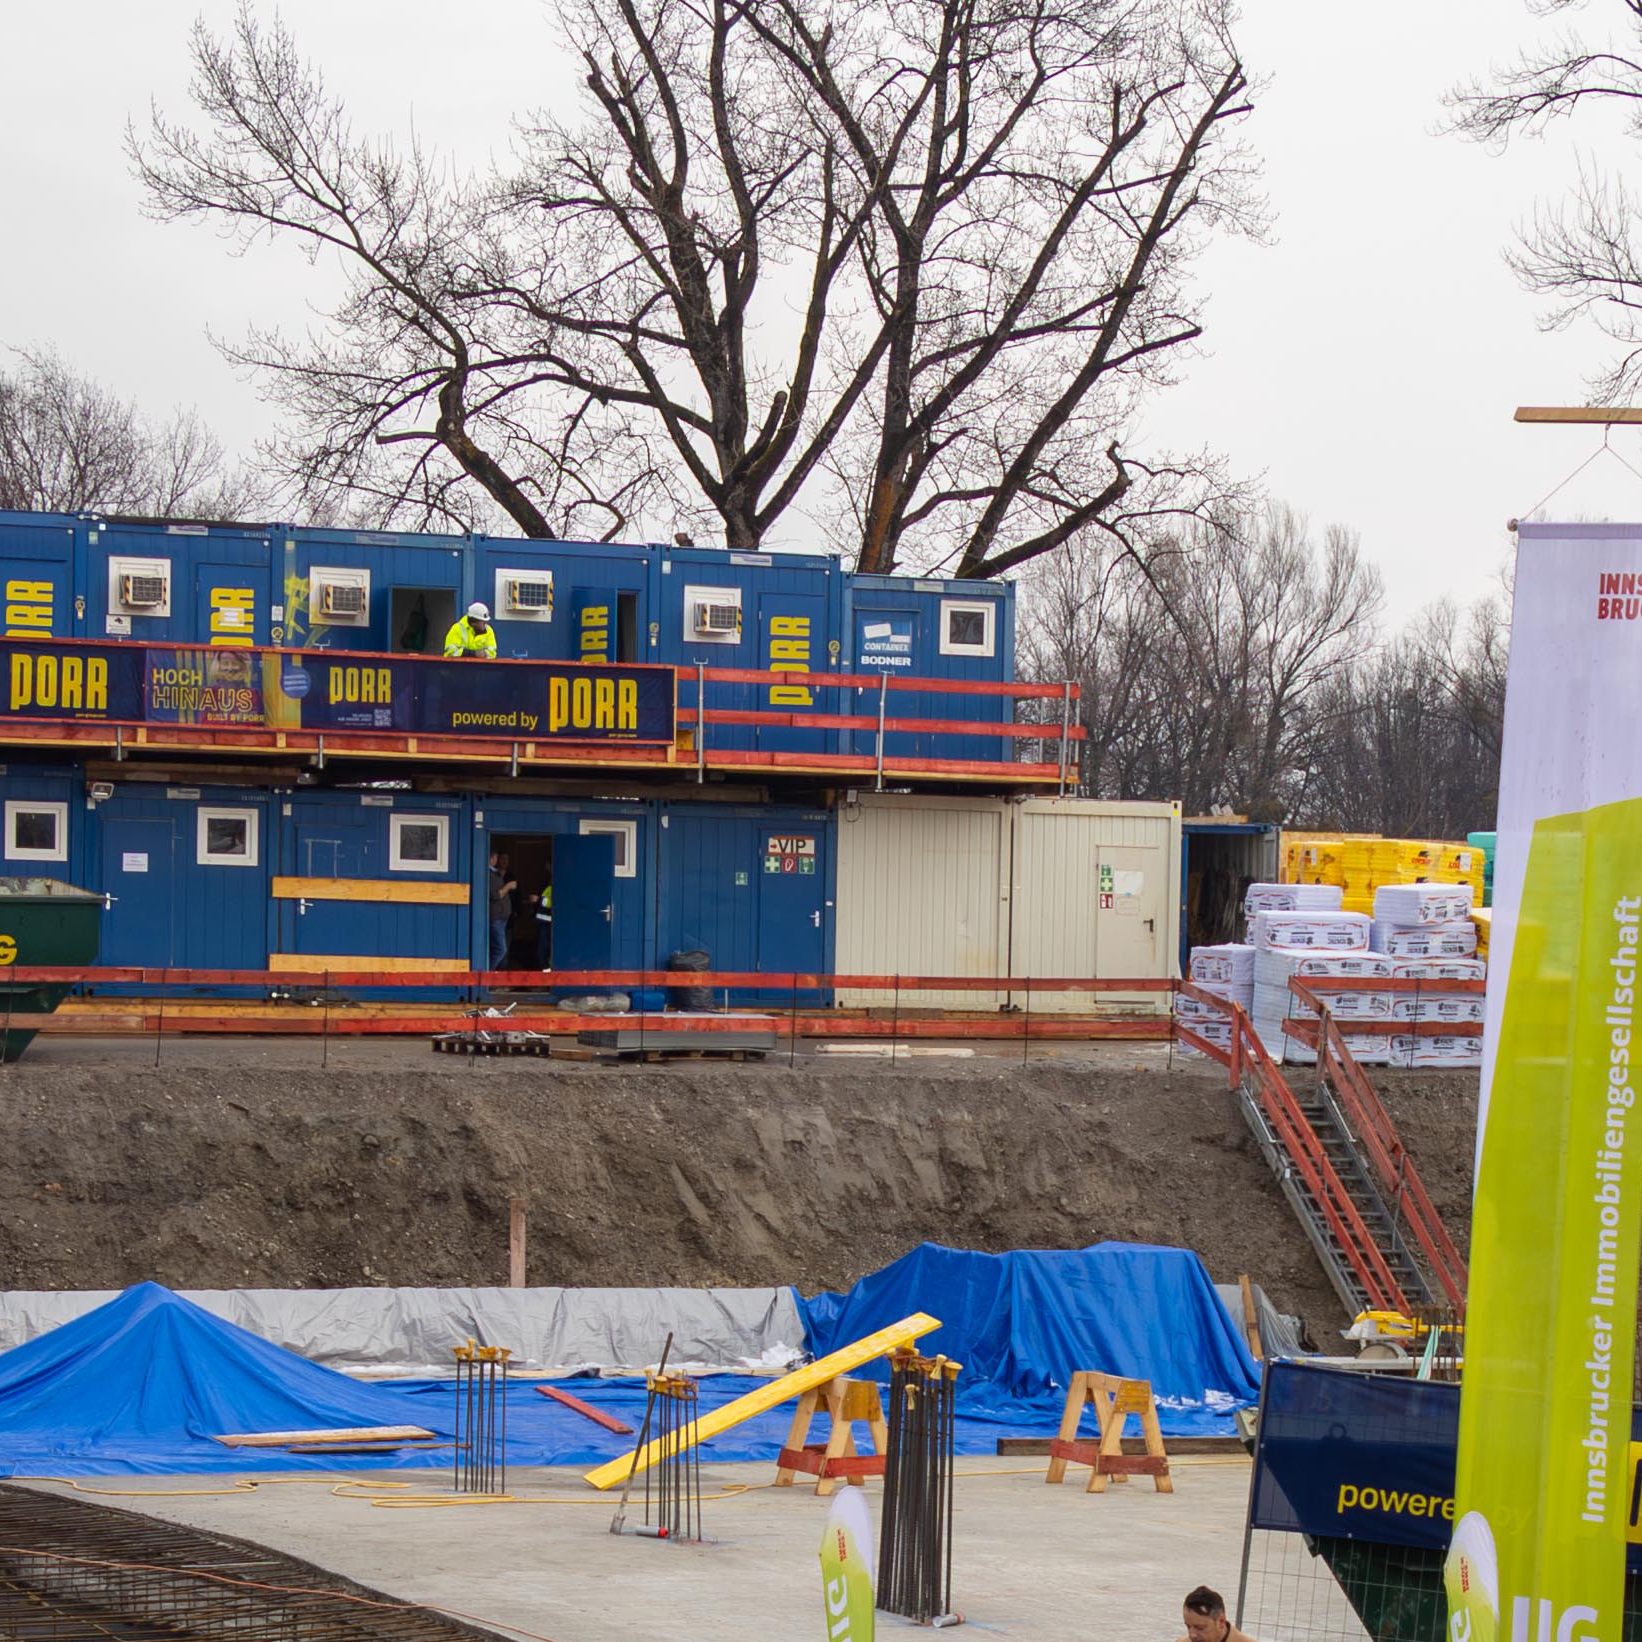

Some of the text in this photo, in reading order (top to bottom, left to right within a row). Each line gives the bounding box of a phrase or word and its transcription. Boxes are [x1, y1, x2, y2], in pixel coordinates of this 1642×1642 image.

[861, 656, 911, 666] BODNER
[864, 642, 910, 652] CONTAINEX
[10, 653, 107, 710] PORR
[153, 668, 203, 686] HOCH
[329, 666, 391, 705] PORR
[153, 686, 253, 712] HINAUS
[452, 677, 637, 732] powered by PORR
[778, 840, 806, 852] VIP
[1582, 895, 1641, 1523] Innsbrucker Immobiliengesellschaft
[1337, 1483, 1456, 1521] powere
